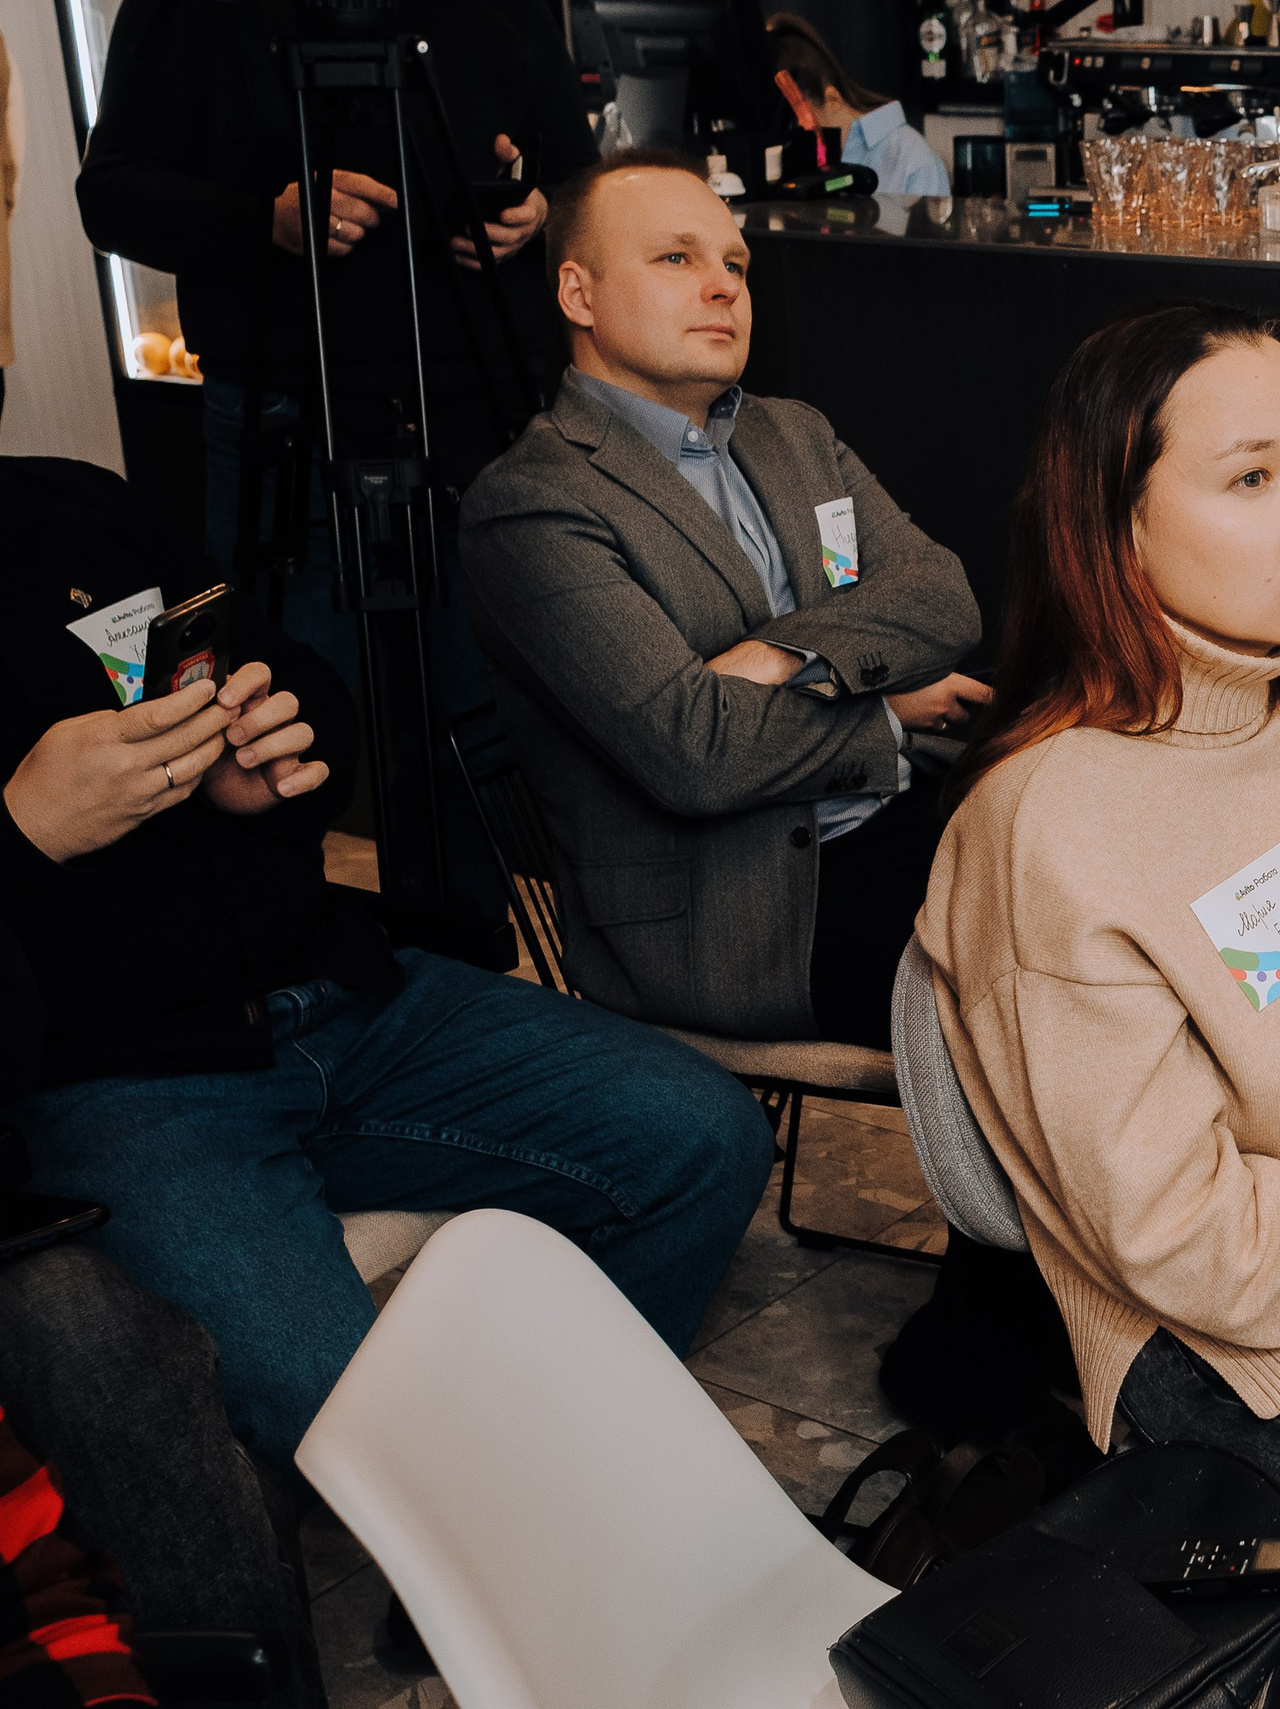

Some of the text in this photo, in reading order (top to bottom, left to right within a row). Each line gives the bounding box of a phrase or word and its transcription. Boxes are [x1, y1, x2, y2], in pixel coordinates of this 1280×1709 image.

[1239, 868, 1278, 898] Avito Работа
[1237, 899, 1277, 937] Мария
